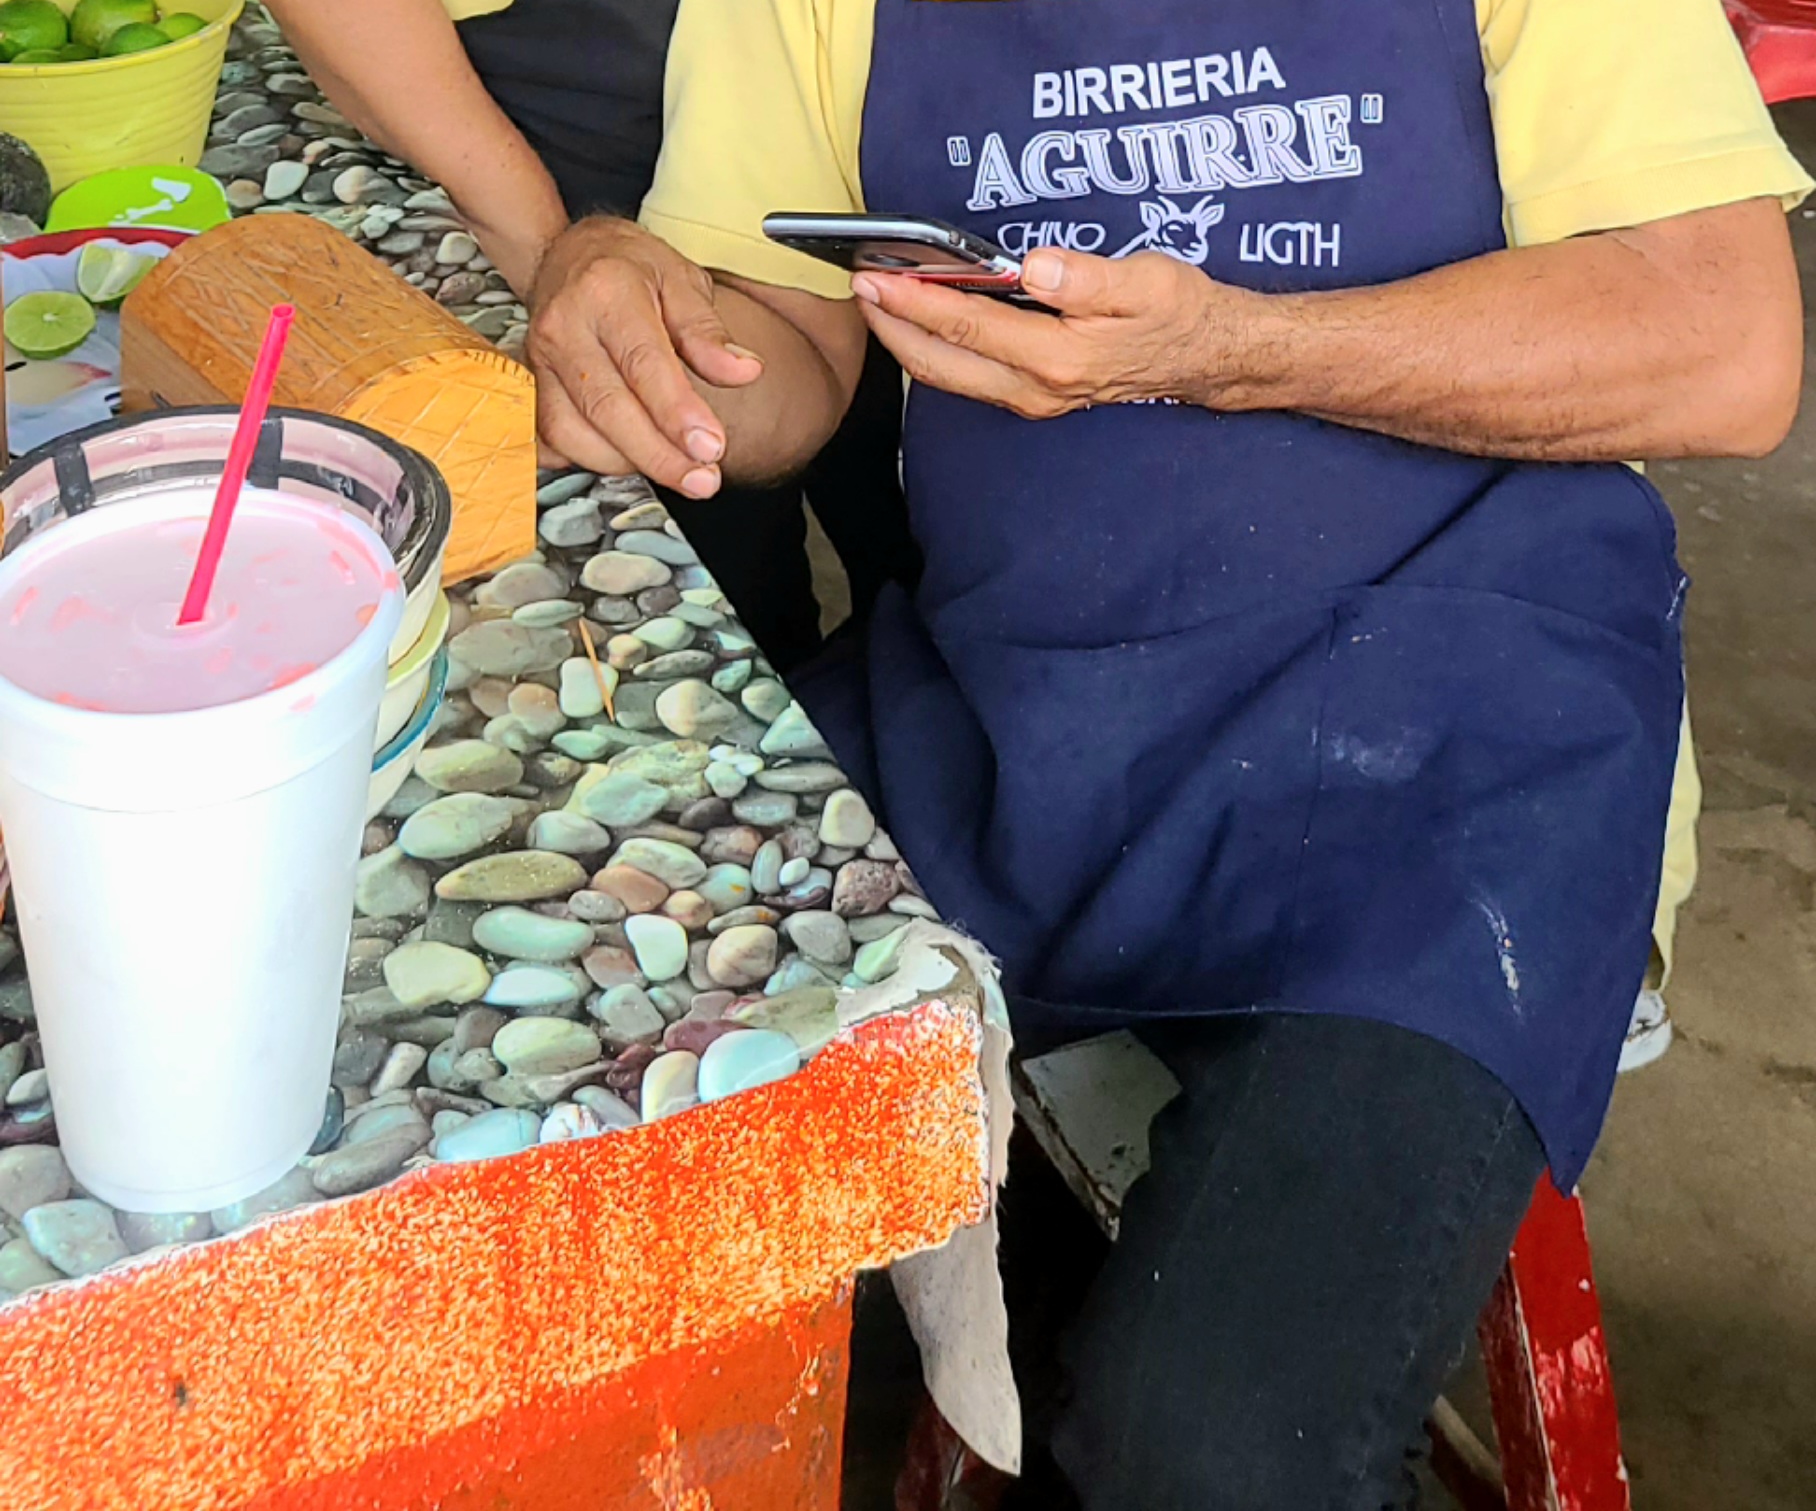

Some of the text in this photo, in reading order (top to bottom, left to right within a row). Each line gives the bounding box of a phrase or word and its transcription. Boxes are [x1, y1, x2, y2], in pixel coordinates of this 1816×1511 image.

[1032, 46, 1287, 119] BIRRIERIA
[997, 222, 1341, 268] CHIVO LIGTH
